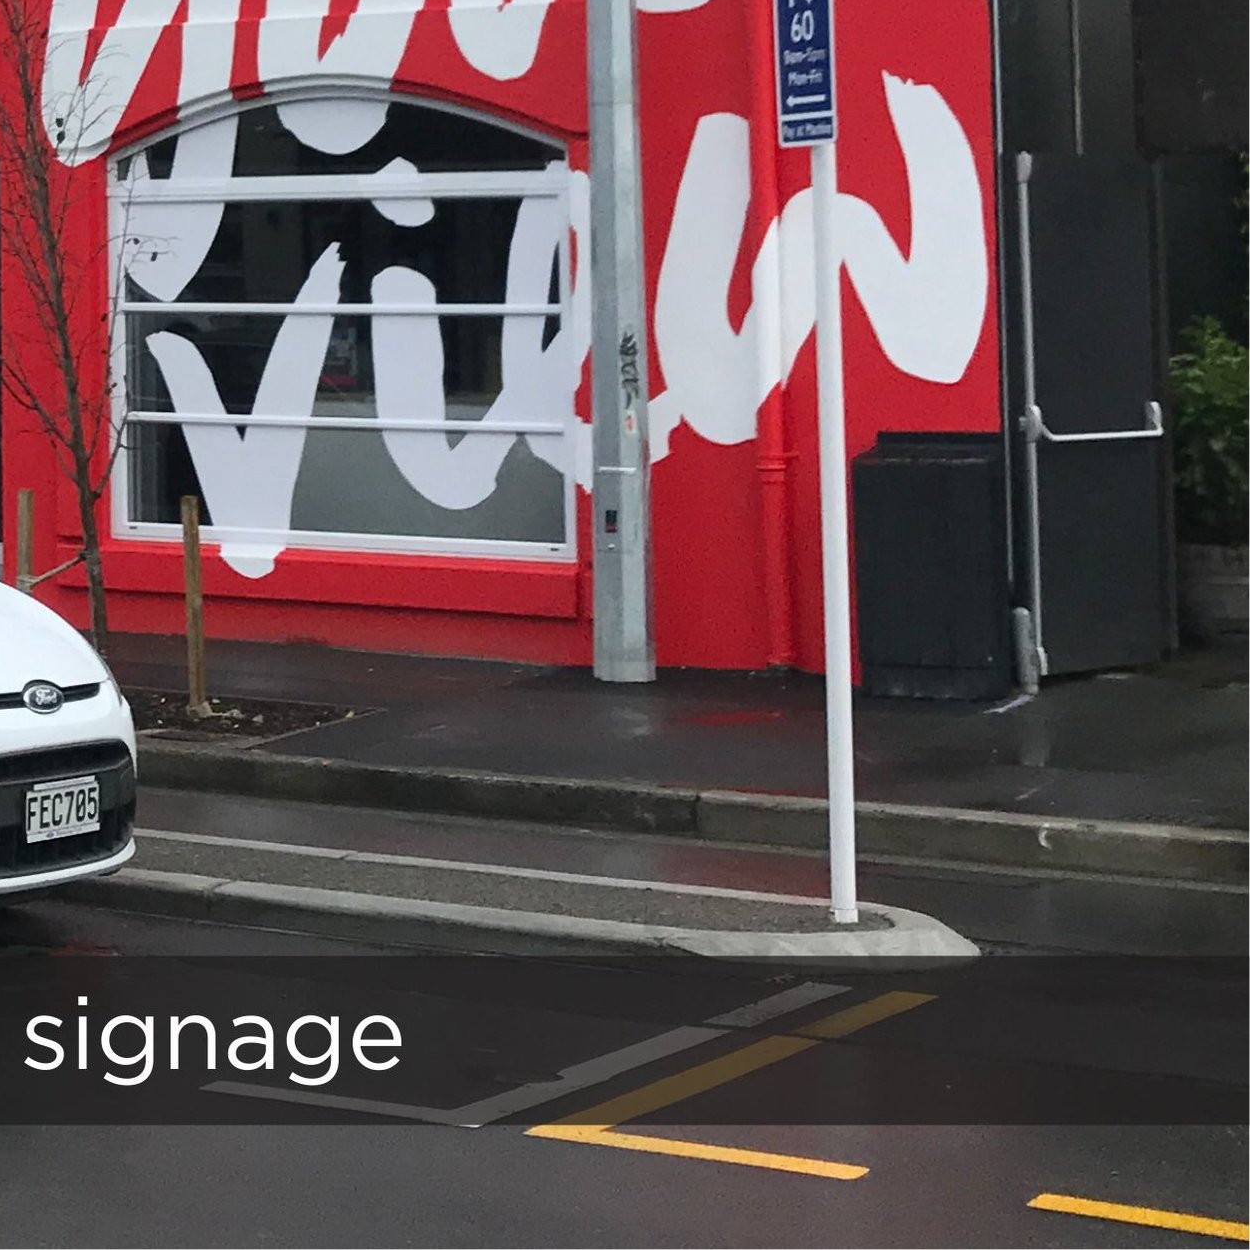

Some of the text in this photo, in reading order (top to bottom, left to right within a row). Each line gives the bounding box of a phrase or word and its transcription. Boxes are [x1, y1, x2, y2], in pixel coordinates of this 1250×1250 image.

[791, 10, 814, 43] 60
[147, 72, 989, 578] view
[27, 787, 97, 832] FEC705
